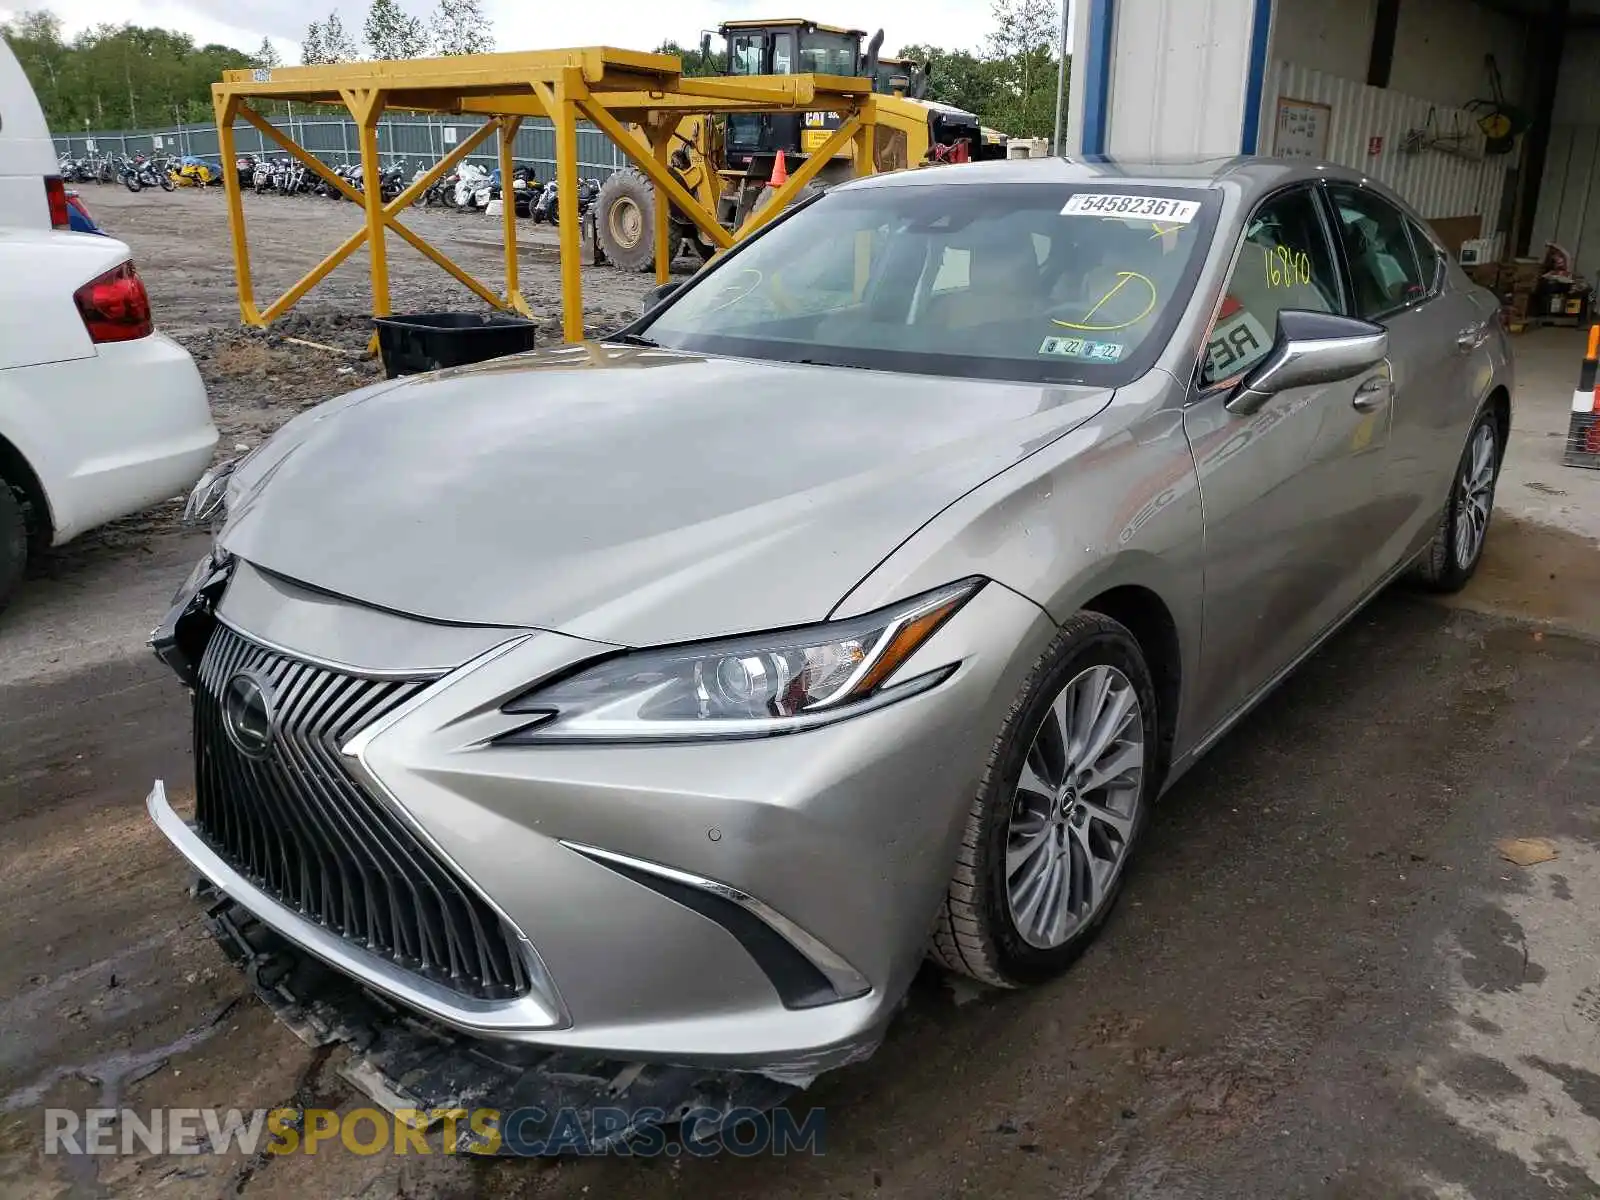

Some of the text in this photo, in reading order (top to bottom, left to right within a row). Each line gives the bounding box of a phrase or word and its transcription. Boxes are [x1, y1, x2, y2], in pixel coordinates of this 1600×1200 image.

[805, 112, 825, 126] CAT
[1080, 195, 1181, 217] 54582361
[1264, 245, 1311, 289] 16840
[1102, 345, 1117, 358] 22
